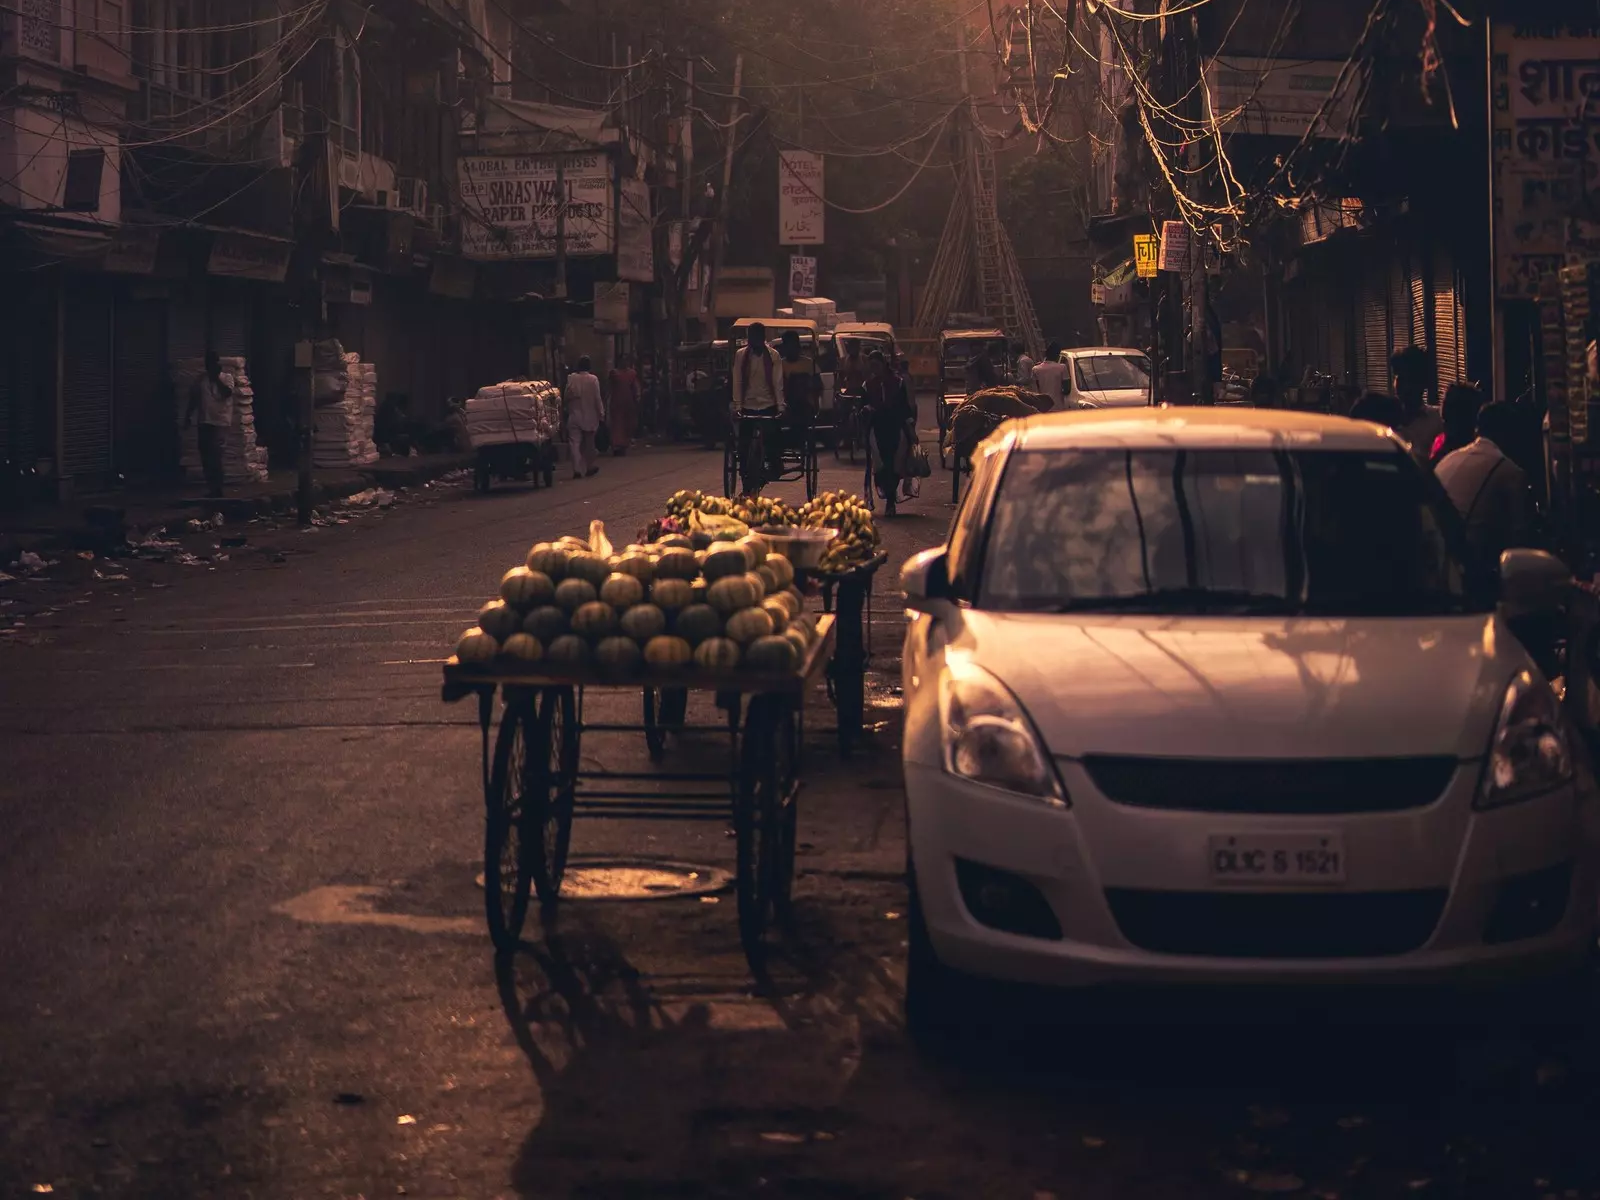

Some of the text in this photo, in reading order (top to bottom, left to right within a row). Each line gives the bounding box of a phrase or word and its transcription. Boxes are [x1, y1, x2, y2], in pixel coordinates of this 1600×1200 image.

[463, 159, 508, 173] GLOBAL
[515, 156, 598, 170] ENTERRISES
[781, 160, 817, 170] HOTEL
[489, 179, 574, 205] SARASWAI
[484, 207, 526, 222] PAPER
